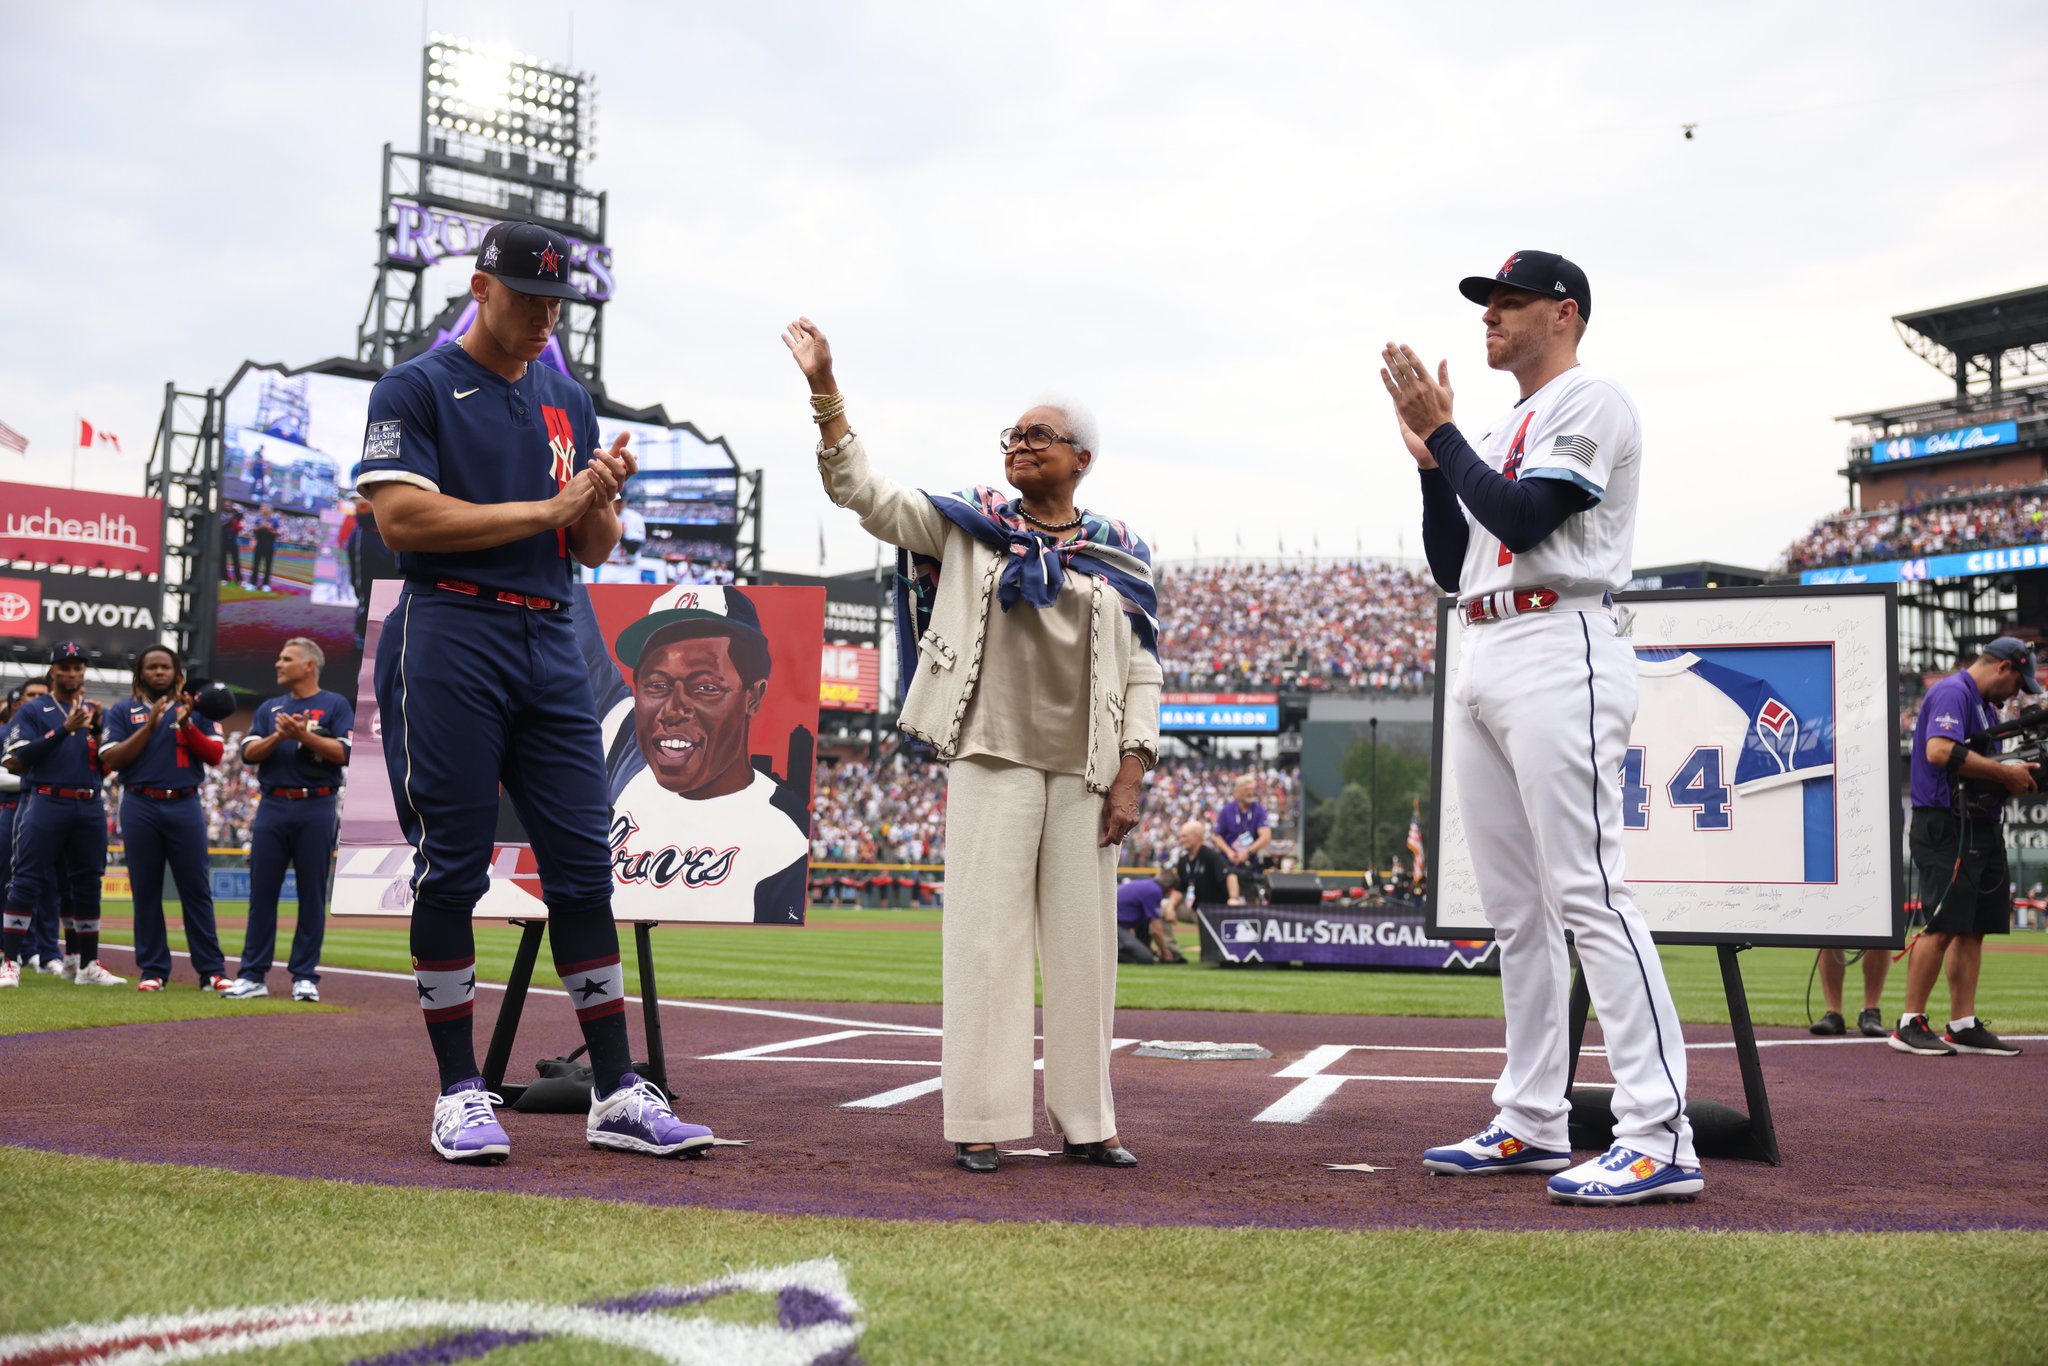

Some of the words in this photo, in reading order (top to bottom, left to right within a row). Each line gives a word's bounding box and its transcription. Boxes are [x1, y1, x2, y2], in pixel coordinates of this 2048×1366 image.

[371, 439, 394, 449] GAME
[7, 506, 138, 548] uchealth
[1902, 559, 1927, 581] 44
[42, 599, 155, 630] TOYOTA
[1161, 711, 1206, 725] HANK
[1210, 711, 1268, 725] AARON
[1376, 921, 1450, 948] GAM
